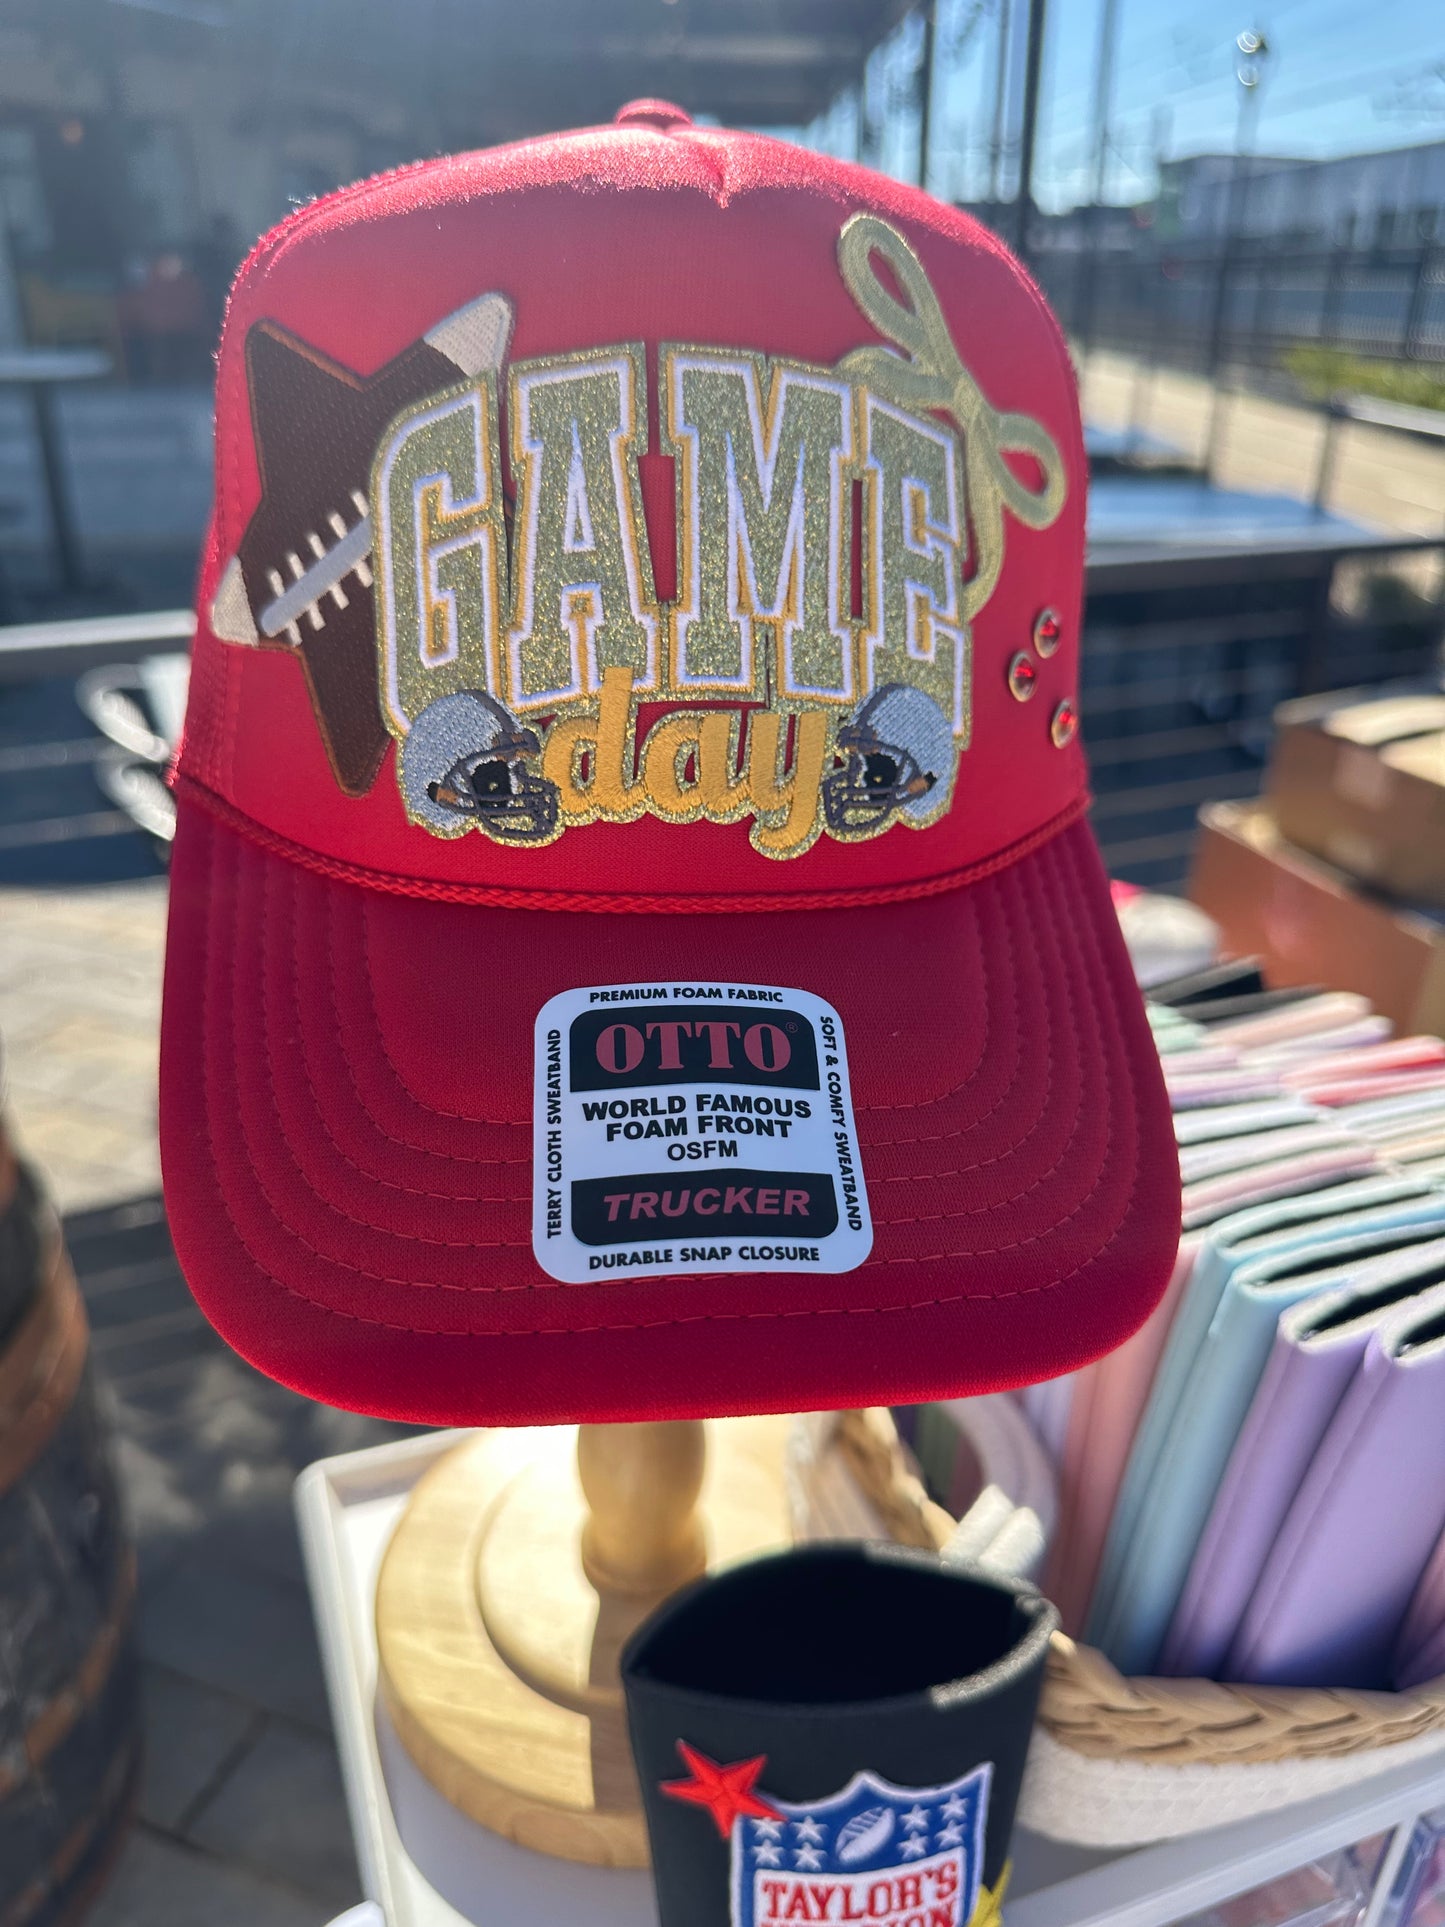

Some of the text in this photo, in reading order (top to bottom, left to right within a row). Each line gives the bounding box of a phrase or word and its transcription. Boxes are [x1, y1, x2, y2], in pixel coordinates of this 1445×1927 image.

[377, 352, 968, 738] GAME
[543, 667, 828, 850] day
[589, 987, 784, 1003] PREMIUM FOAM FABRIC
[582, 1093, 812, 1122] WORLD FAMOUS
[820, 1015, 863, 1232] SOFT & COMFY SWEATBAND
[547, 1029, 562, 1239] TERRY CLOTH SWEATBAND
[606, 1115, 793, 1142] FOAM FRONT
[667, 1139, 739, 1162] OSFM
[603, 1186, 811, 1222] TRUCKER
[589, 1246, 820, 1270] DURABLE SNAP CLOSURE
[762, 1860, 959, 1922] TAYLOR'S
